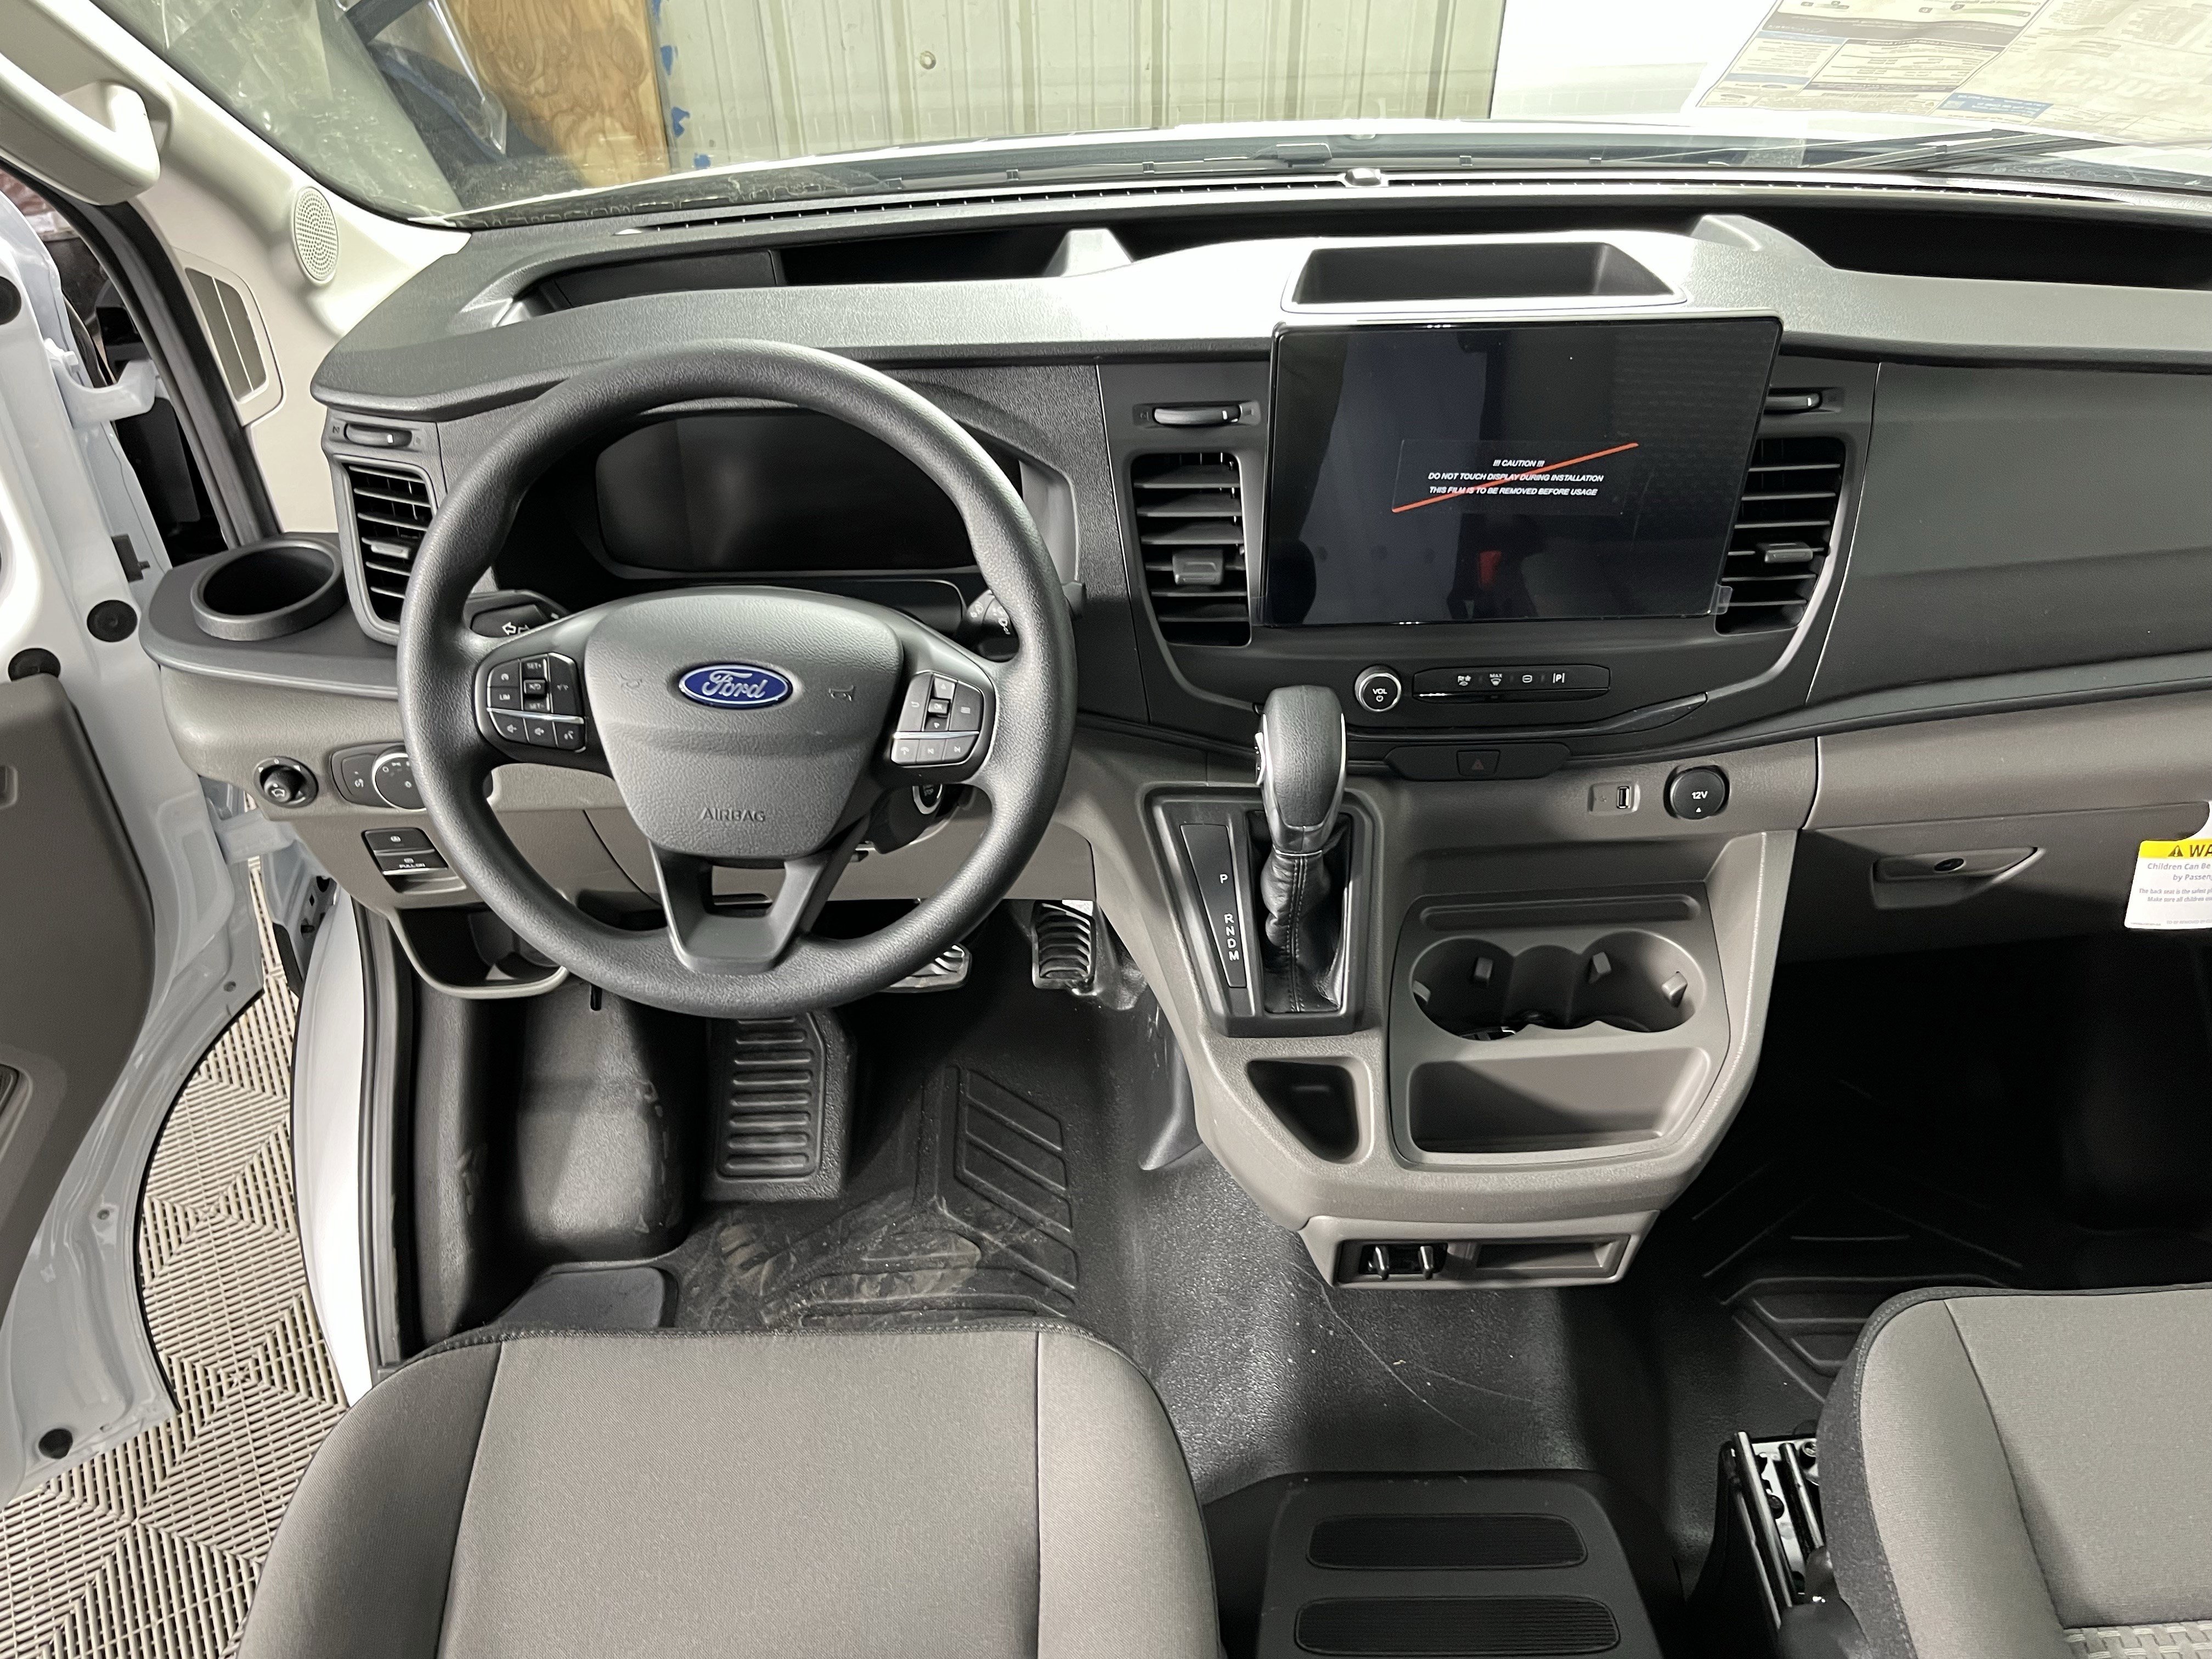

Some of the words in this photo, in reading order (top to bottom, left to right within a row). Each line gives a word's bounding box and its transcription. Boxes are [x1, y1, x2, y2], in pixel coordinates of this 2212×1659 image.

[702, 670, 768, 698] Ford
[1691, 791, 1708, 799] 12V
[701, 807, 765, 822] AIRBAG
[1220, 874, 1228, 884] P
[2172, 874, 2183, 882] by
[1224, 913, 1234, 924] R
[1226, 926, 1235, 936] N
[1227, 938, 1237, 949] D
[1228, 950, 1239, 961] M
